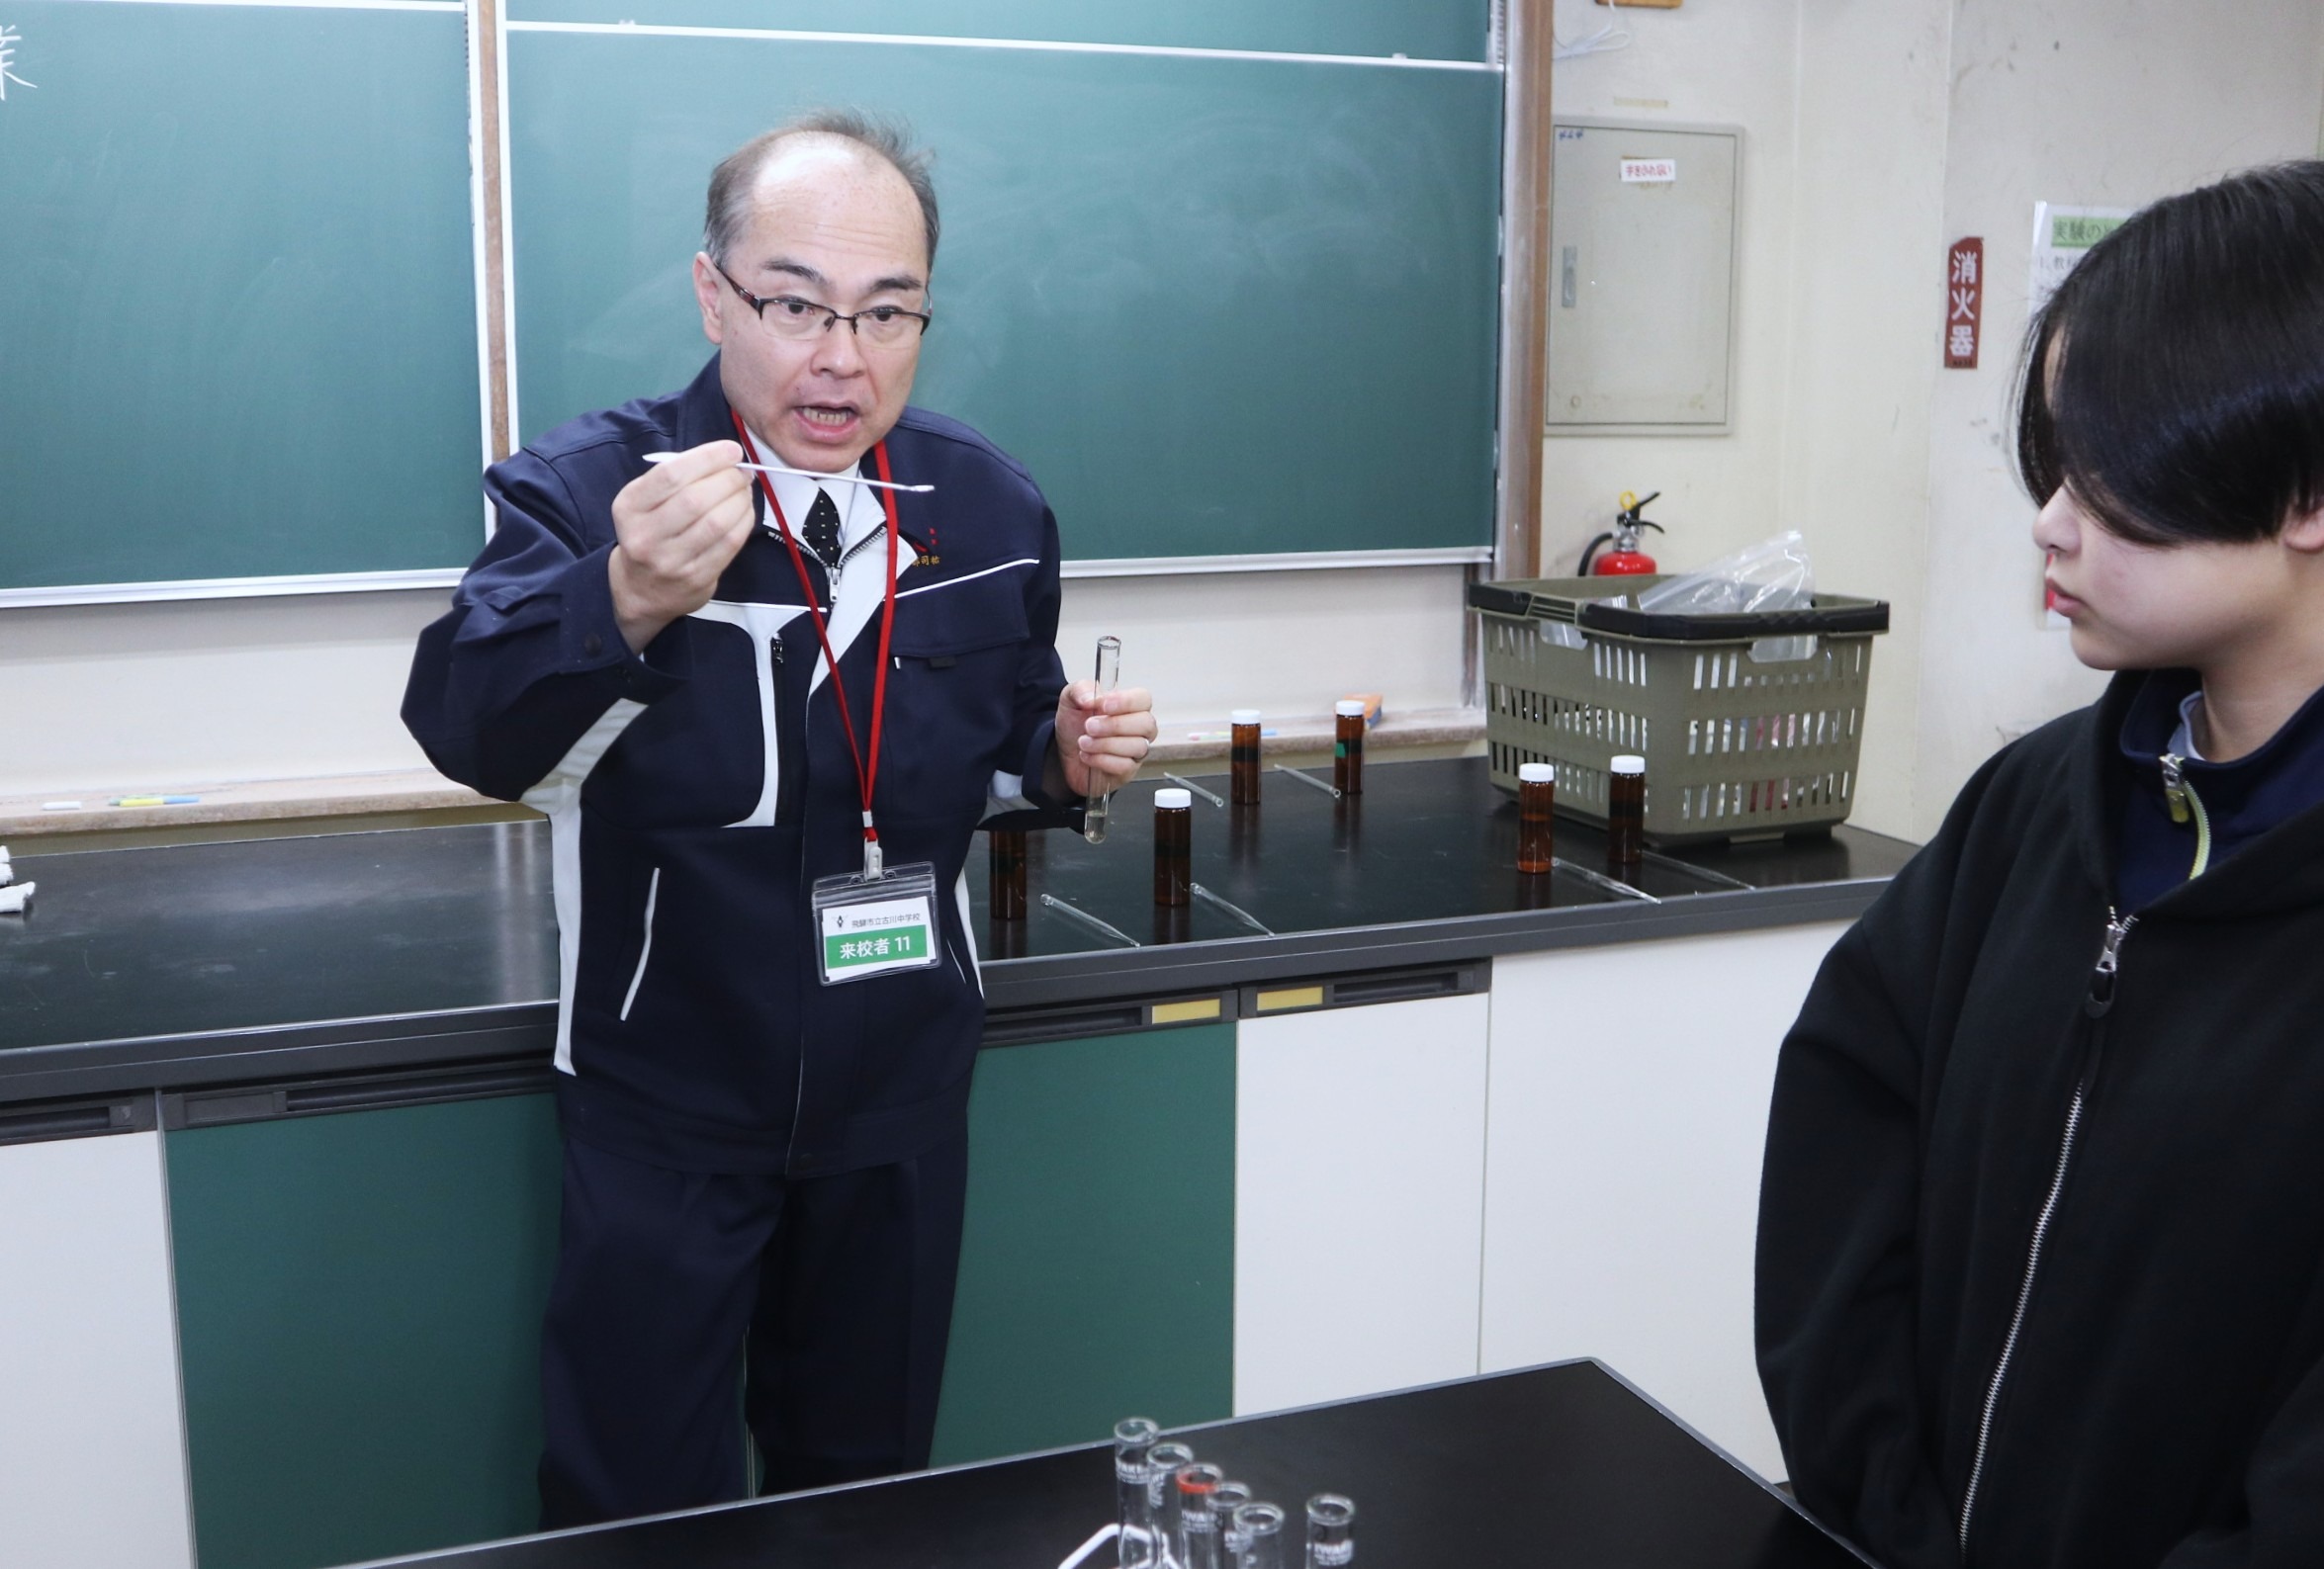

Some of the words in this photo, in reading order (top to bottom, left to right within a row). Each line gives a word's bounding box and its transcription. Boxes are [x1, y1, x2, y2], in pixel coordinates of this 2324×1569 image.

[1949, 250, 1977, 357] 消火器
[851, 913, 921, 928] 飛騨市立古川中学校
[840, 937, 890, 960] 来校者
[894, 935, 911, 952] 11
